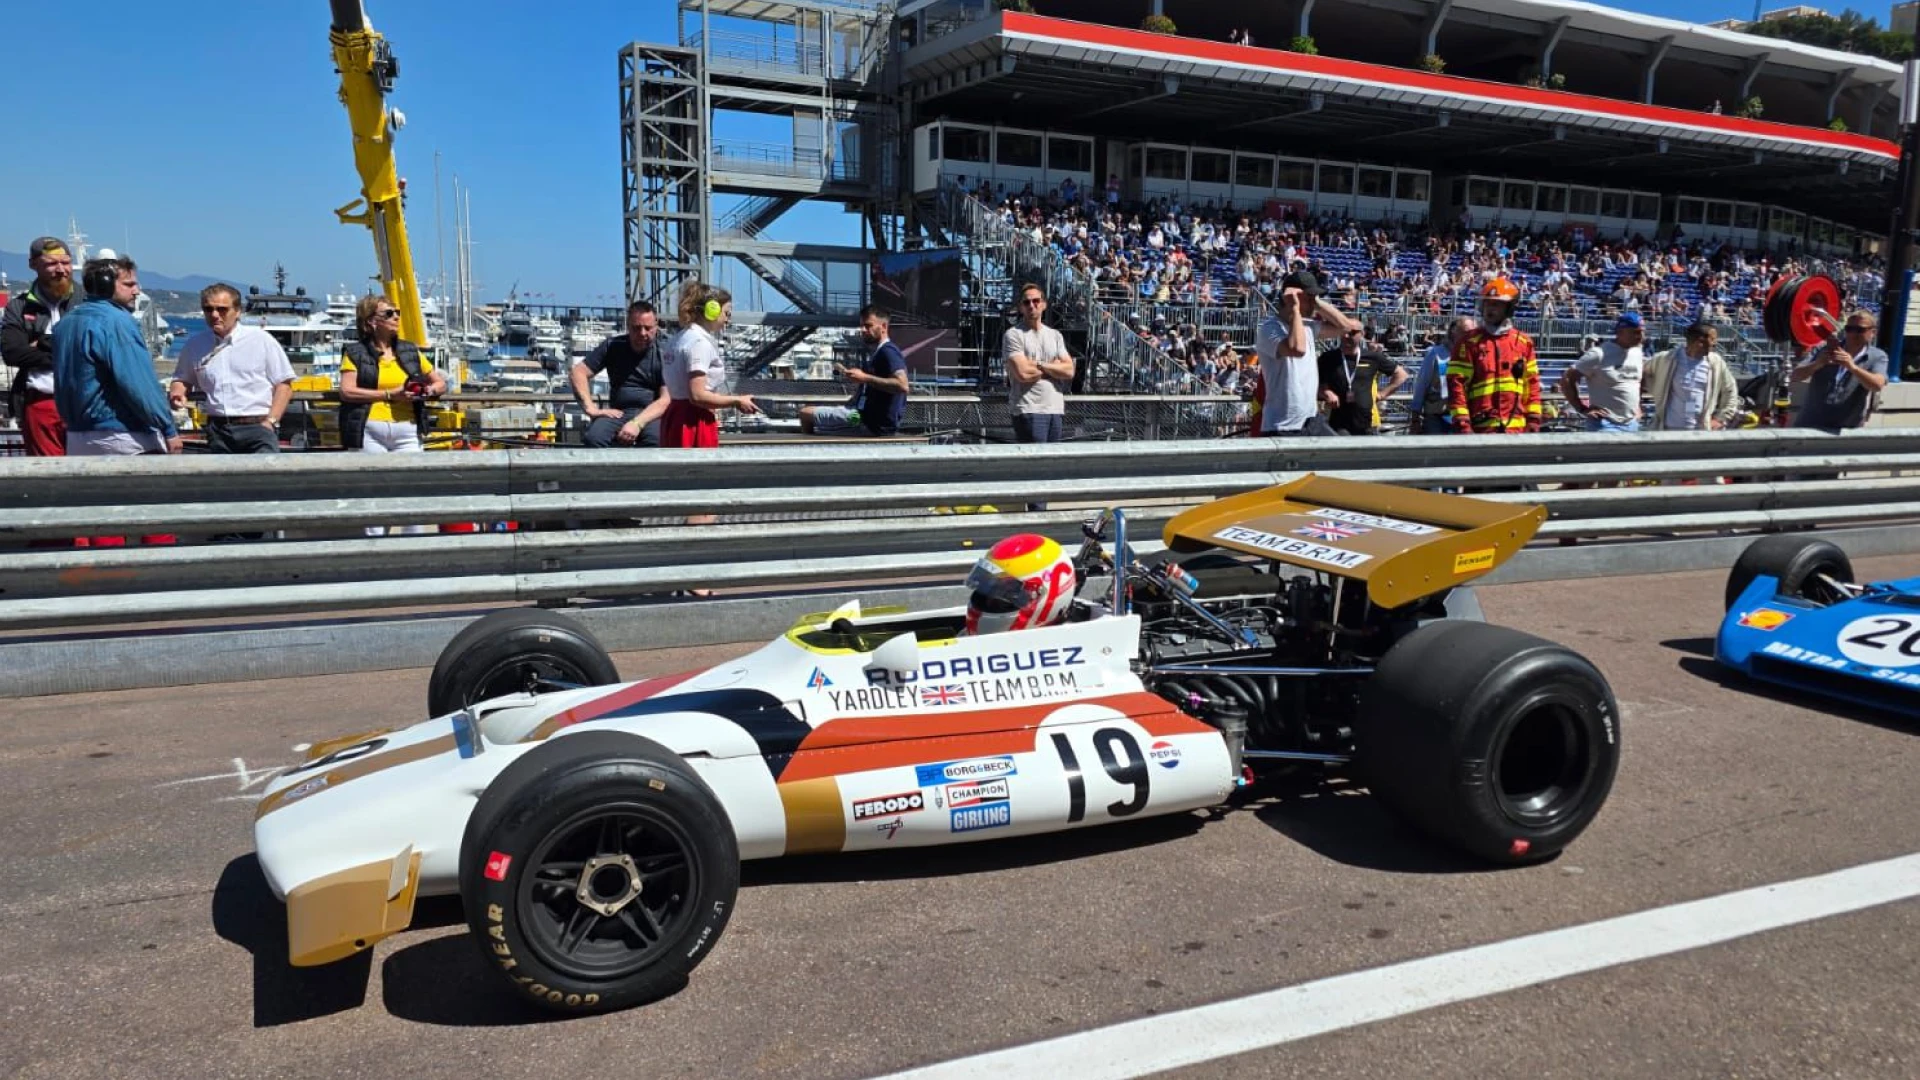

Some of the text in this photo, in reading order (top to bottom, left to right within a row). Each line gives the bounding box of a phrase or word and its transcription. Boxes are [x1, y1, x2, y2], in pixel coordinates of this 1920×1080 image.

[1222, 527, 1358, 566] TEAM B.R.M.
[866, 647, 1086, 686] RODRIGUEZ
[1763, 641, 1849, 669] MATRA
[828, 685, 918, 712] YARDLEY
[966, 678, 1026, 703] TEAM
[1150, 748, 1183, 759] PEPSI
[945, 761, 1013, 777] BORG&BECK
[1050, 727, 1151, 823] 19
[854, 795, 923, 818] FERODO
[952, 785, 1005, 800] CHAMPION
[953, 806, 1010, 831] GIRLING
[488, 903, 600, 1006] GOODYEAR
